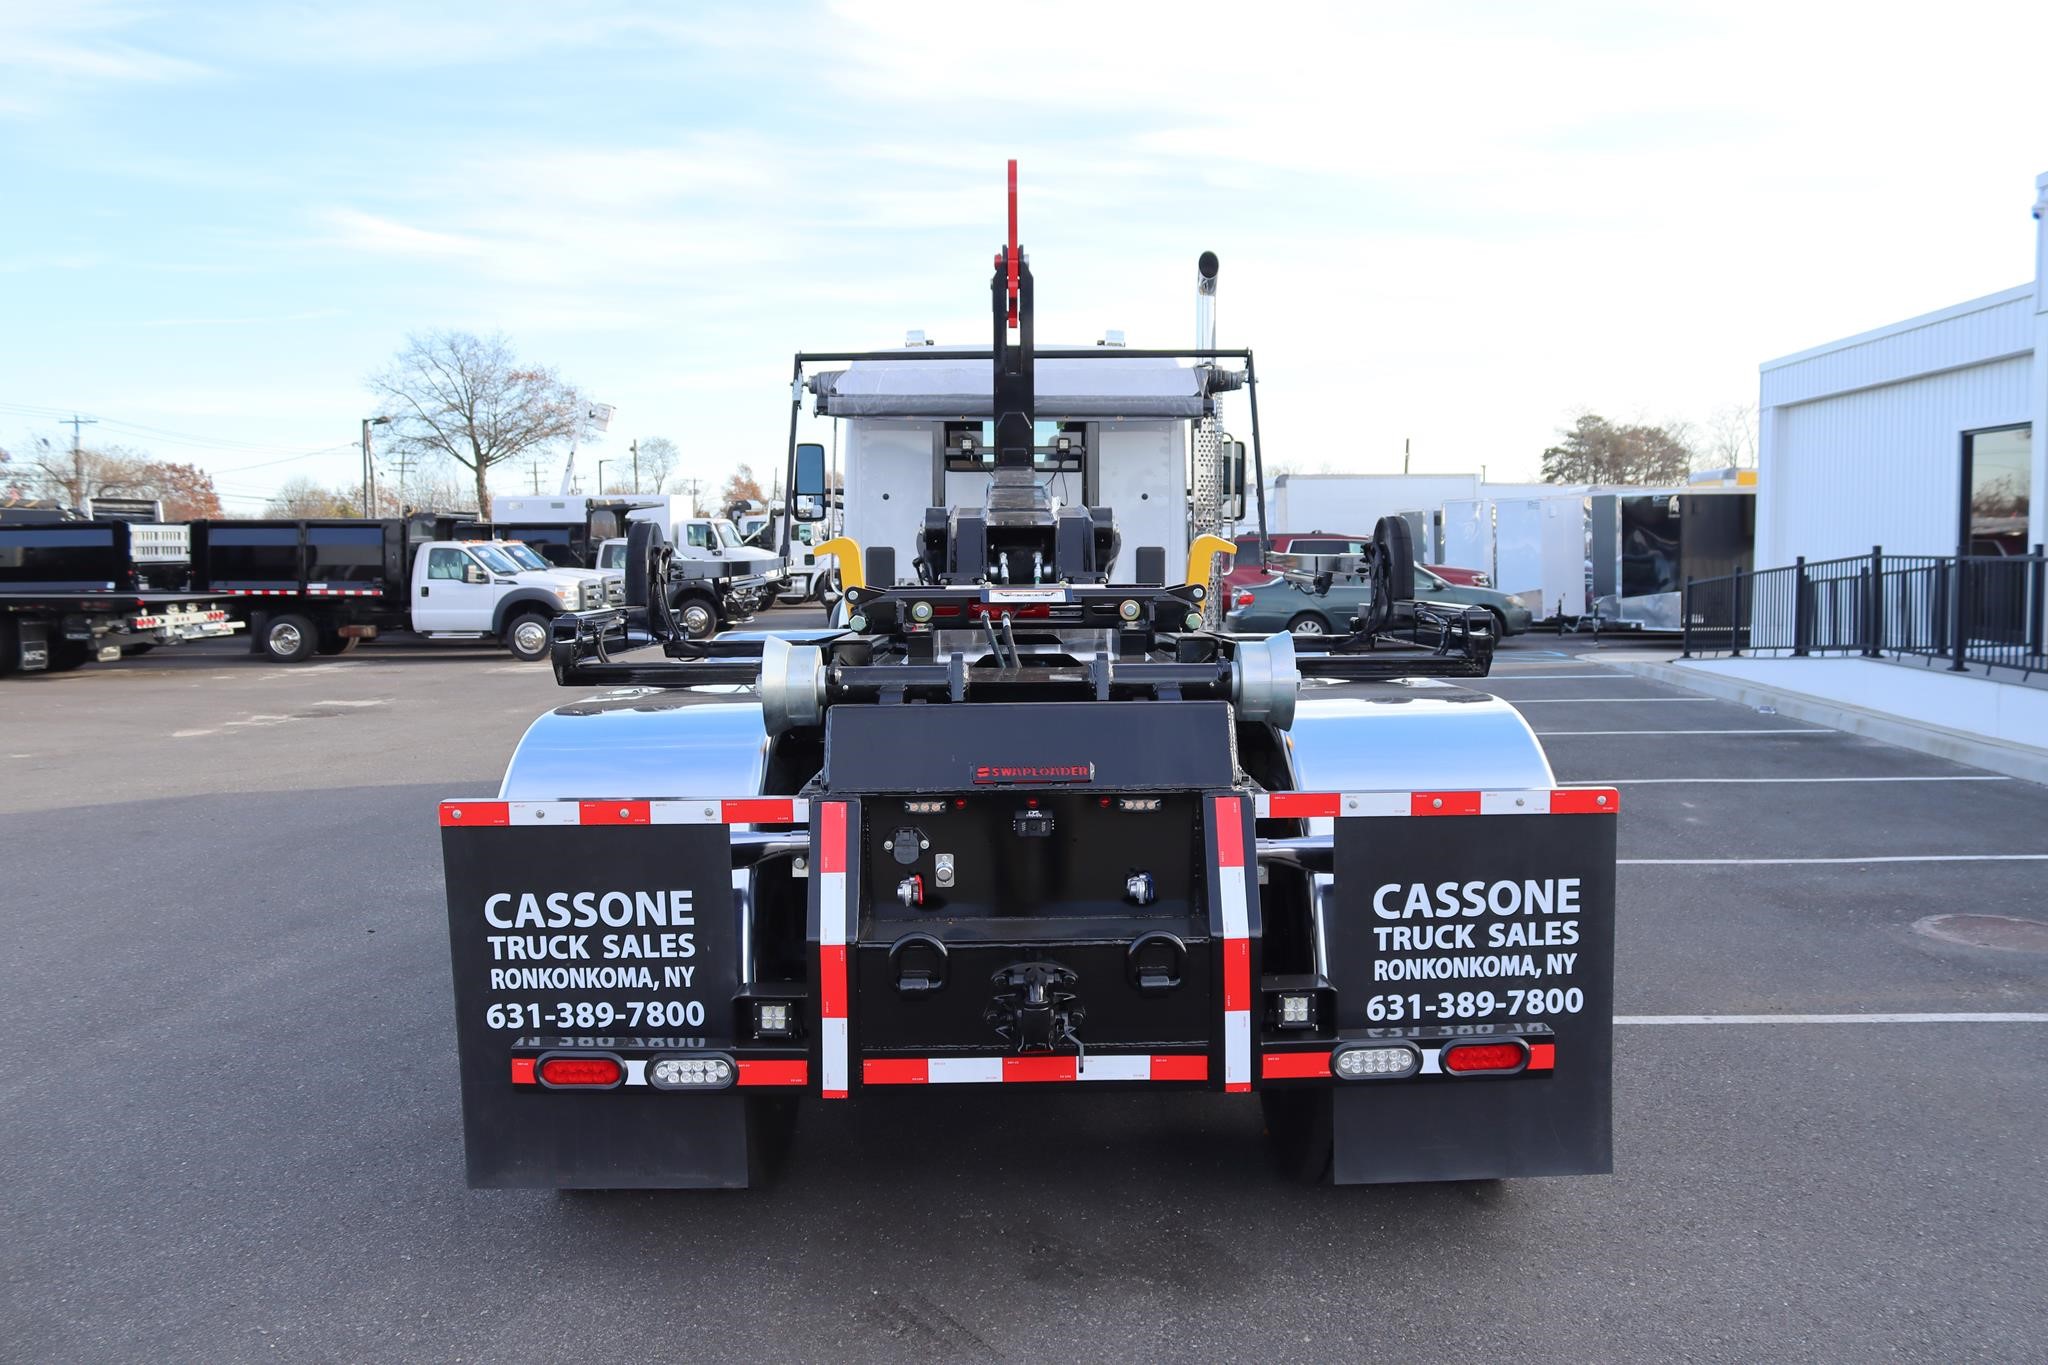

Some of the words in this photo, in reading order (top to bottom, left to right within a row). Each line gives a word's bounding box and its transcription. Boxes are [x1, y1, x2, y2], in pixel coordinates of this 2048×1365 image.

[992, 766, 1089, 777] SWAPLOADER
[485, 891, 694, 928] CASSONE
[1373, 878, 1580, 919] CASSONE
[487, 935, 590, 960] TRUCK
[603, 933, 695, 958] SALES
[1374, 924, 1475, 951] TRUCK
[1488, 921, 1579, 947] SALES
[491, 967, 660, 991] RONKONKOMA,
[665, 966, 695, 987] NY
[1375, 954, 1542, 981] RONKONKOMA,
[1547, 953, 1577, 975] NY
[487, 1001, 704, 1029] 631-389-7800
[1367, 988, 1583, 1021] 631-389-7800
